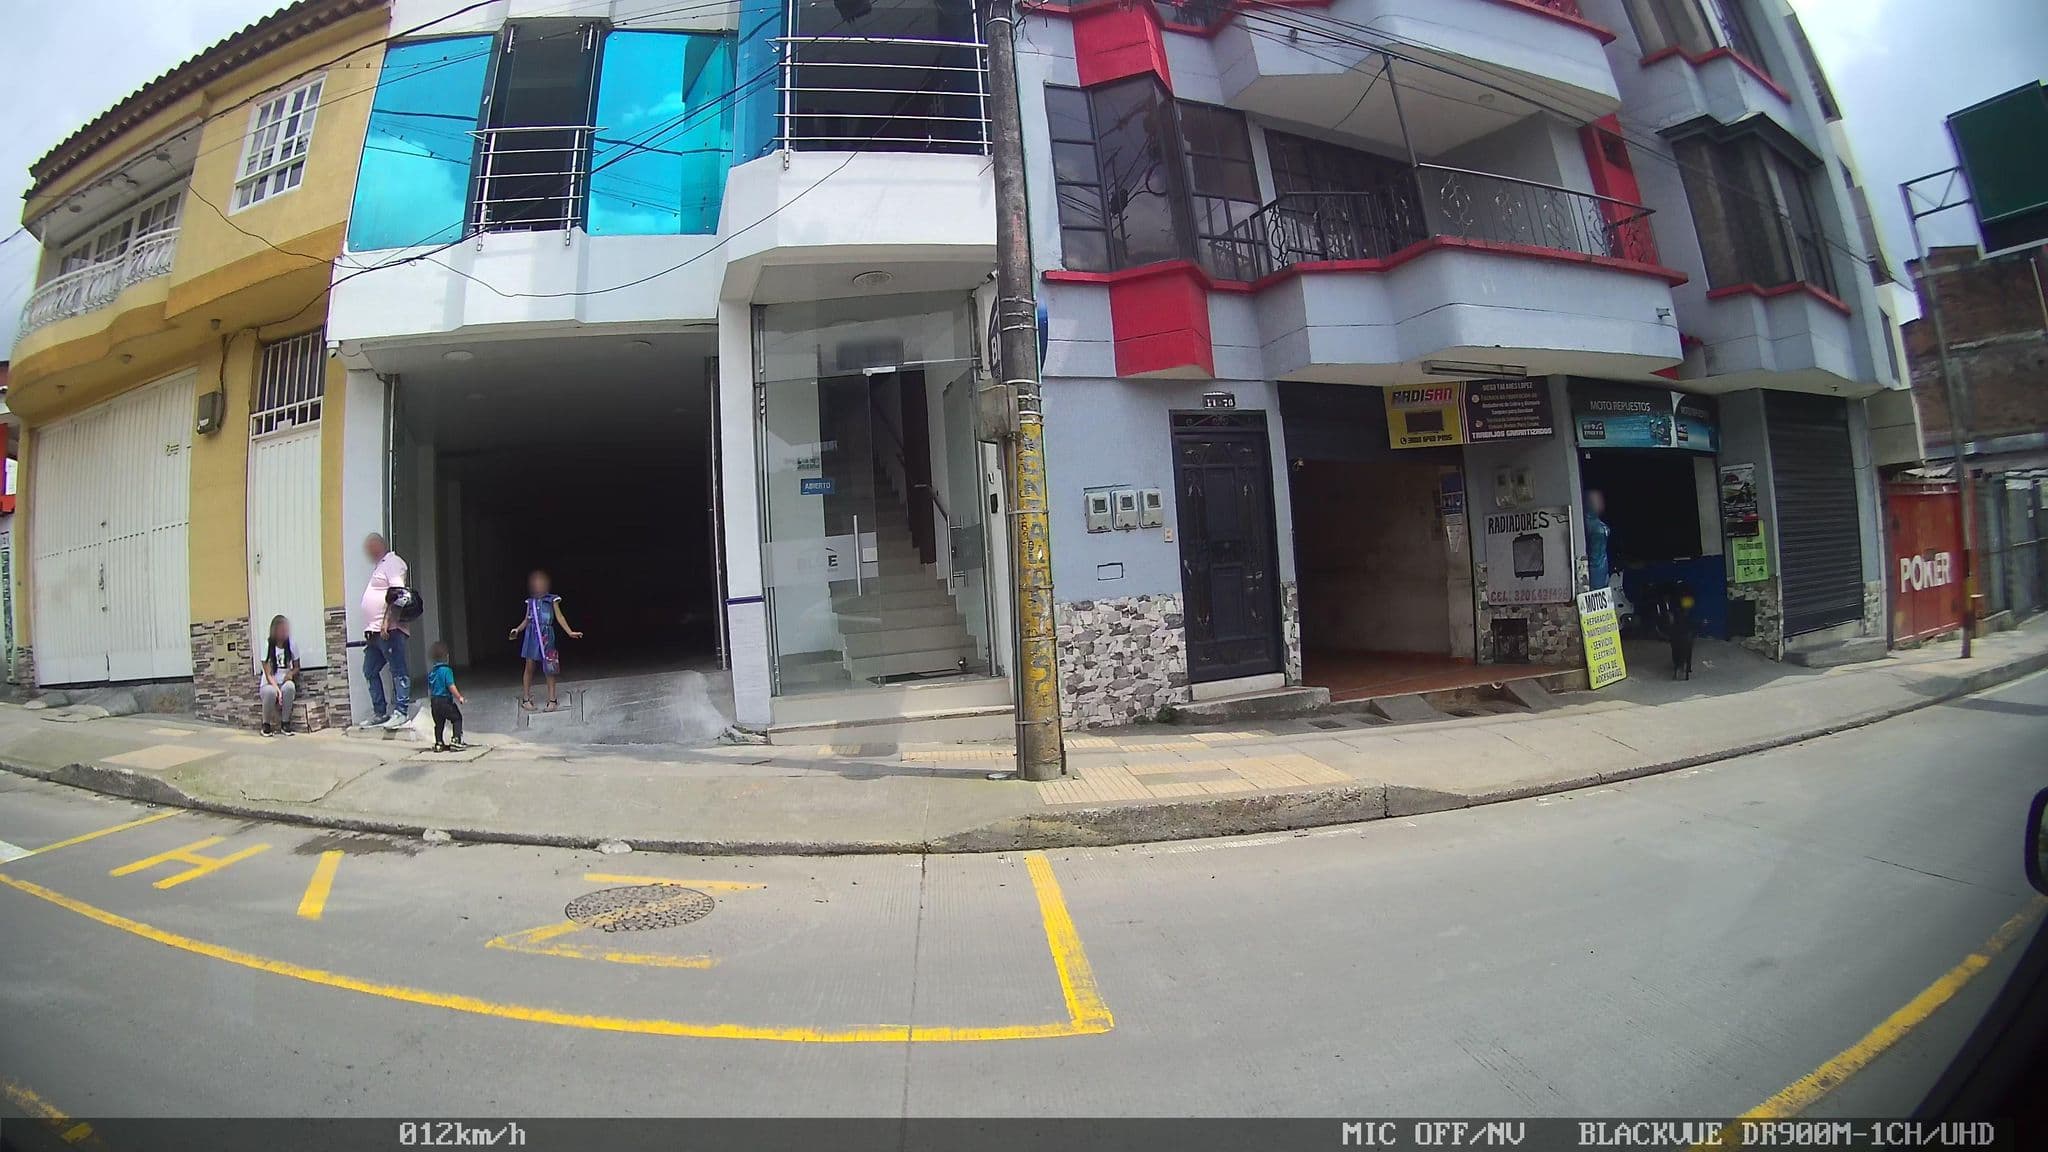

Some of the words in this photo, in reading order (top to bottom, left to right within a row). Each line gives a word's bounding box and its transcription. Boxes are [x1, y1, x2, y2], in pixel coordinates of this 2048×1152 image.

[1391, 387, 1453, 402] RADISAN
[1590, 400, 1612, 411] MOTO
[1613, 401, 1651, 412] REPUESTOS
[1506, 428, 1552, 437] GARANTIZADOS
[804, 482, 831, 491] ABIERTO
[1488, 511, 1550, 535] RADIADORES
[1899, 551, 1952, 593] POKER
[1584, 591, 1608, 613] MOTOS
[1592, 637, 1614, 650] SERVICIO
[1611, 660, 1618, 669] DE
